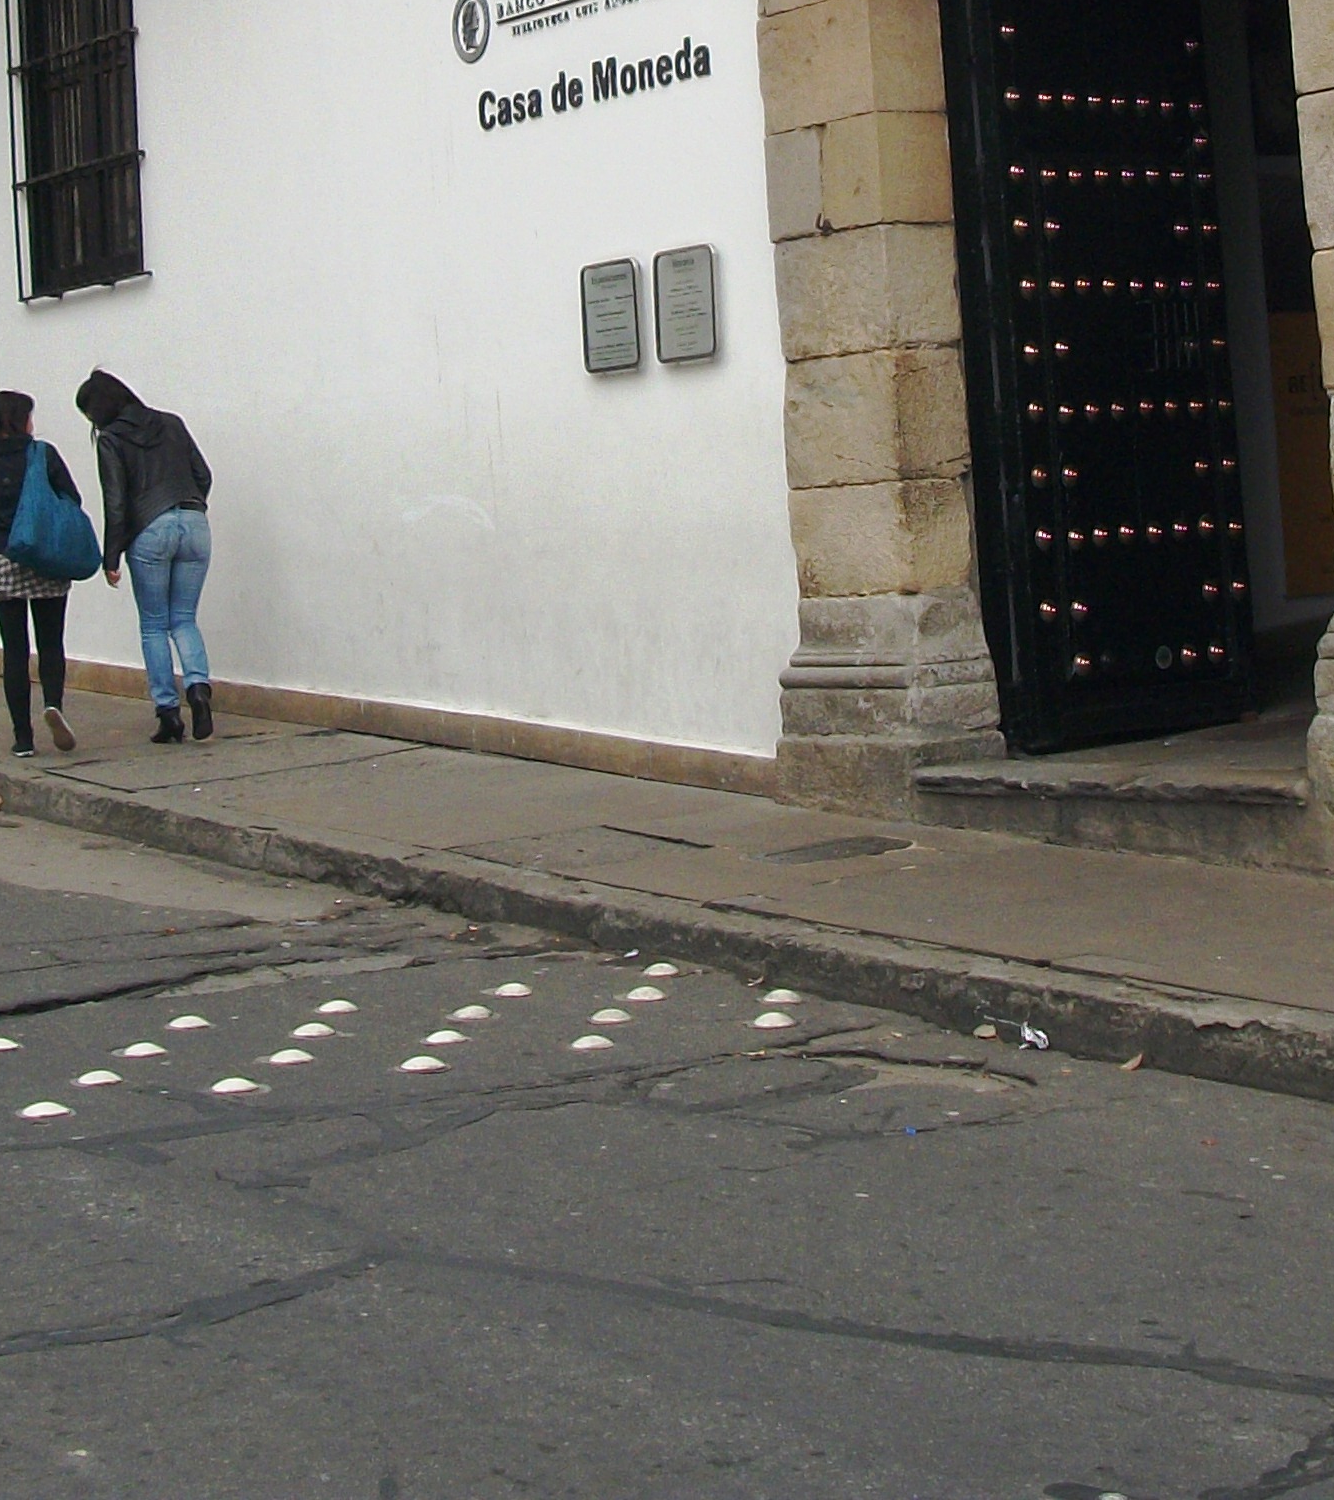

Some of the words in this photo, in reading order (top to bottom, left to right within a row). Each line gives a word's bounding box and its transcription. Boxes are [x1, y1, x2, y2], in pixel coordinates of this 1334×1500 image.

[479, 90, 543, 131] Casa
[551, 71, 583, 113] de
[591, 36, 712, 103] Moneda
